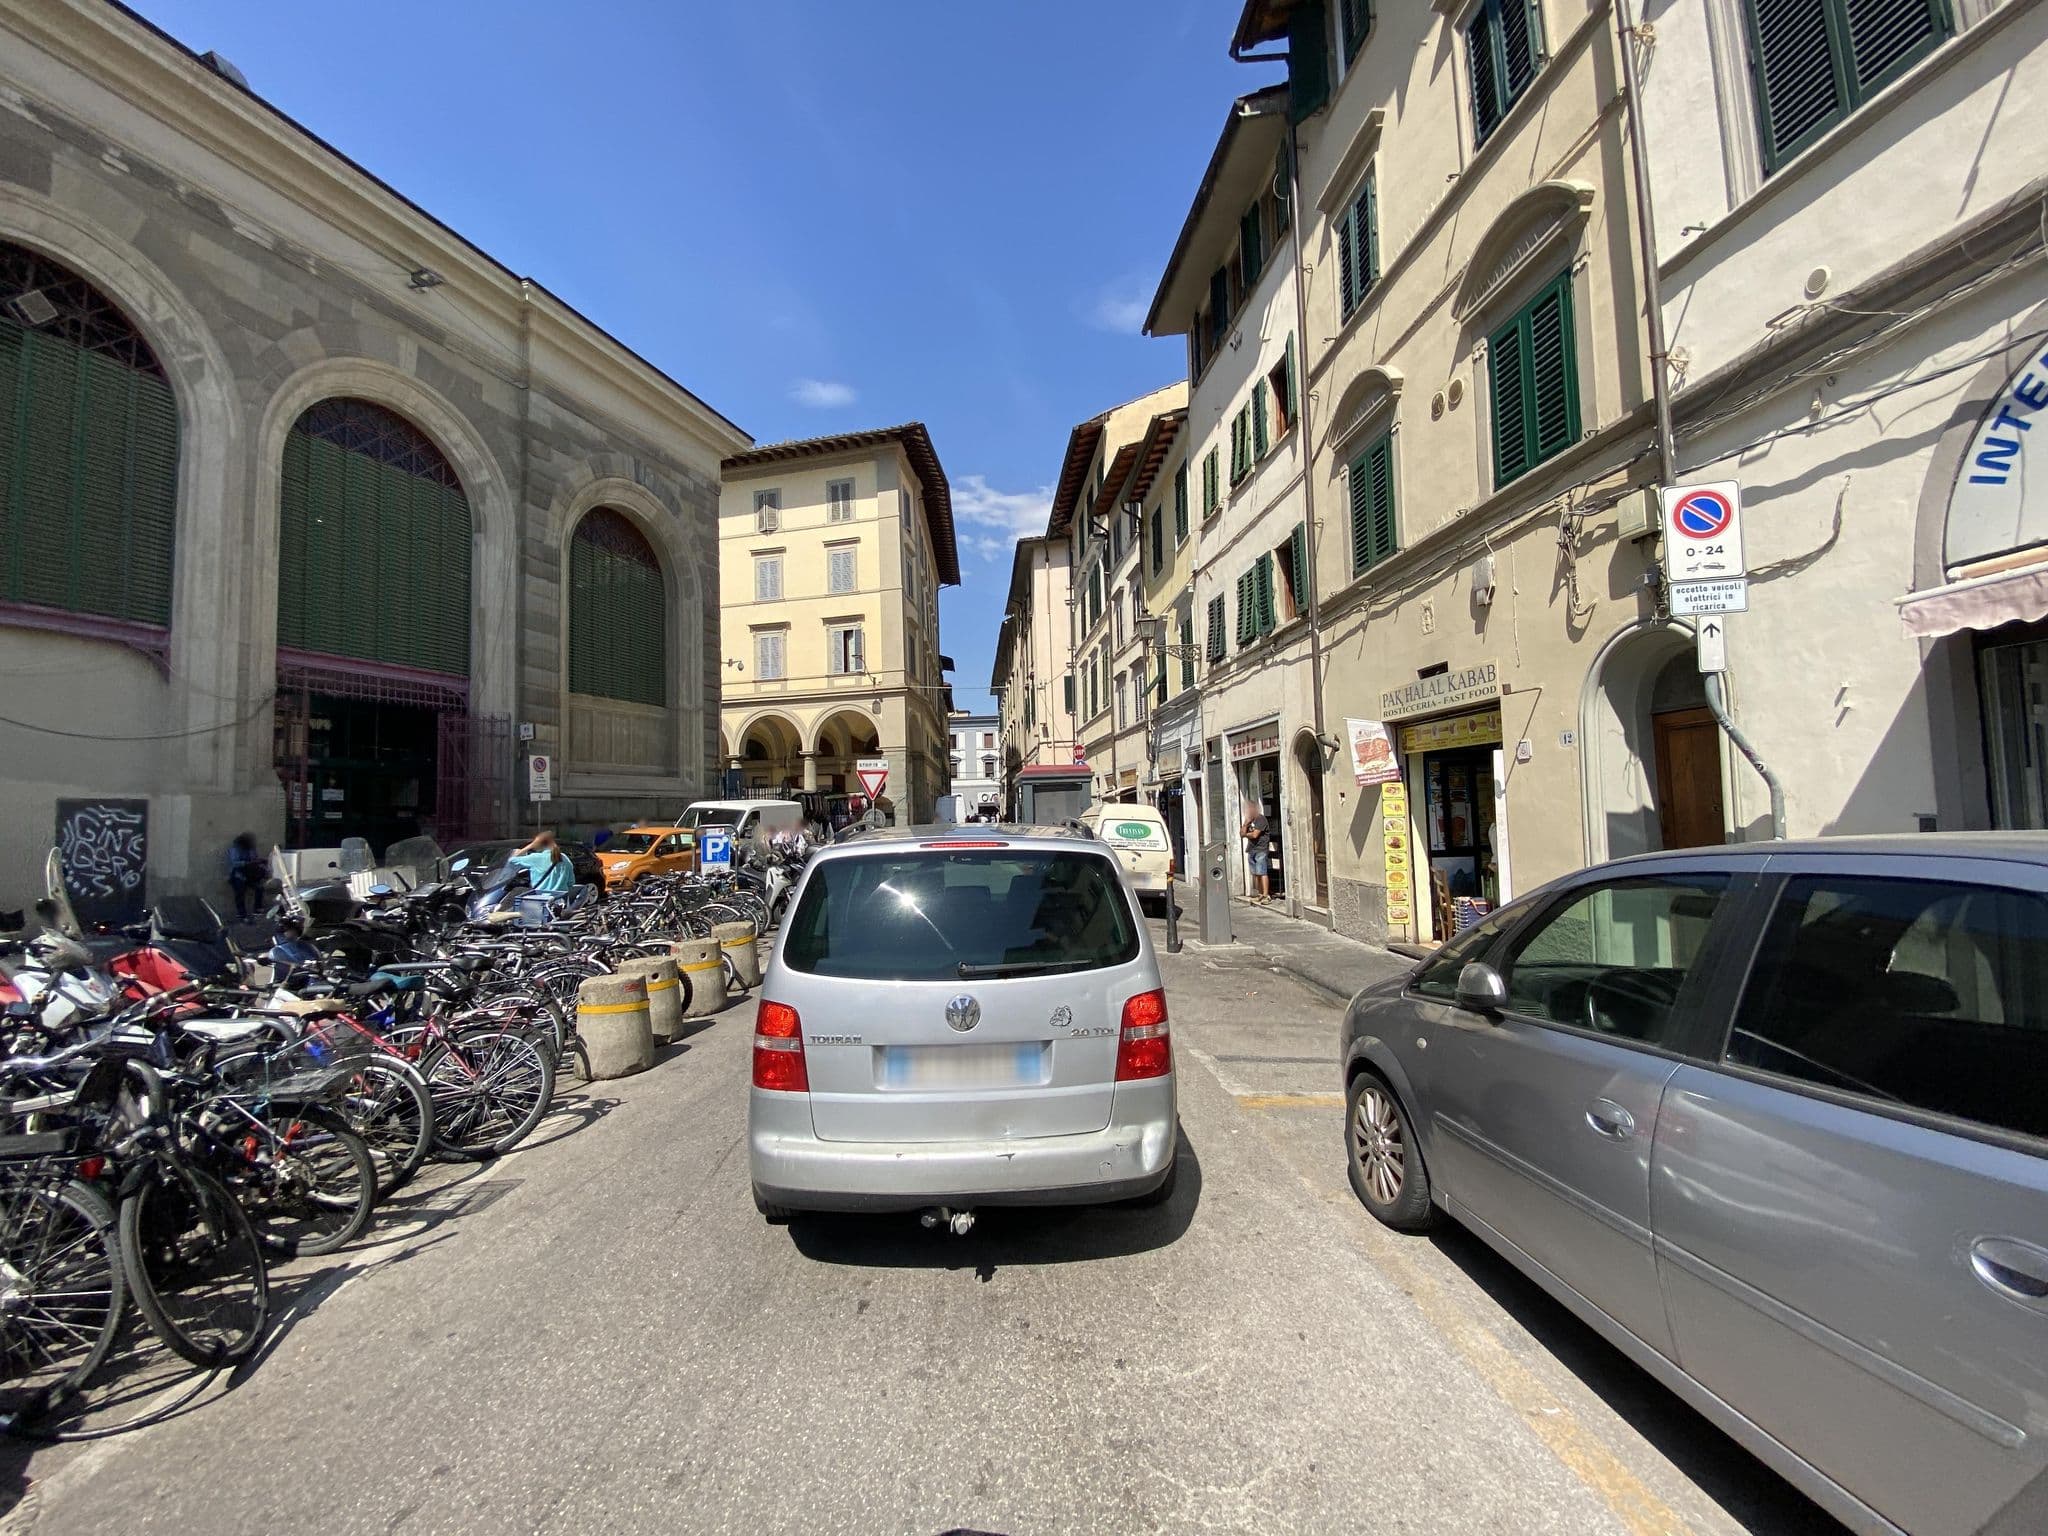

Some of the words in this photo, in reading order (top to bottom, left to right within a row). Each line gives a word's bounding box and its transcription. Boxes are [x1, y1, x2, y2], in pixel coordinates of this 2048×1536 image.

[1968, 352, 2048, 485] INTE
[1705, 544, 1724, 555] 24
[1676, 585, 1708, 594] eccetto
[1711, 582, 1741, 591] veicoli
[1684, 592, 1721, 603] elettrici
[1725, 592, 1734, 600] in
[1692, 603, 1726, 611] ricarica
[1382, 690, 1404, 708] PAK
[1404, 680, 1445, 703] HALAL
[1447, 664, 1497, 692] KABAB
[1383, 701, 1437, 718] ROSTICCERIA
[1443, 692, 1467, 705] FAST
[1469, 685, 1497, 699] FOOD
[707, 838, 725, 861] P
[1093, 1027, 1114, 1035] TDI
[810, 1035, 862, 1044] TOURAN
